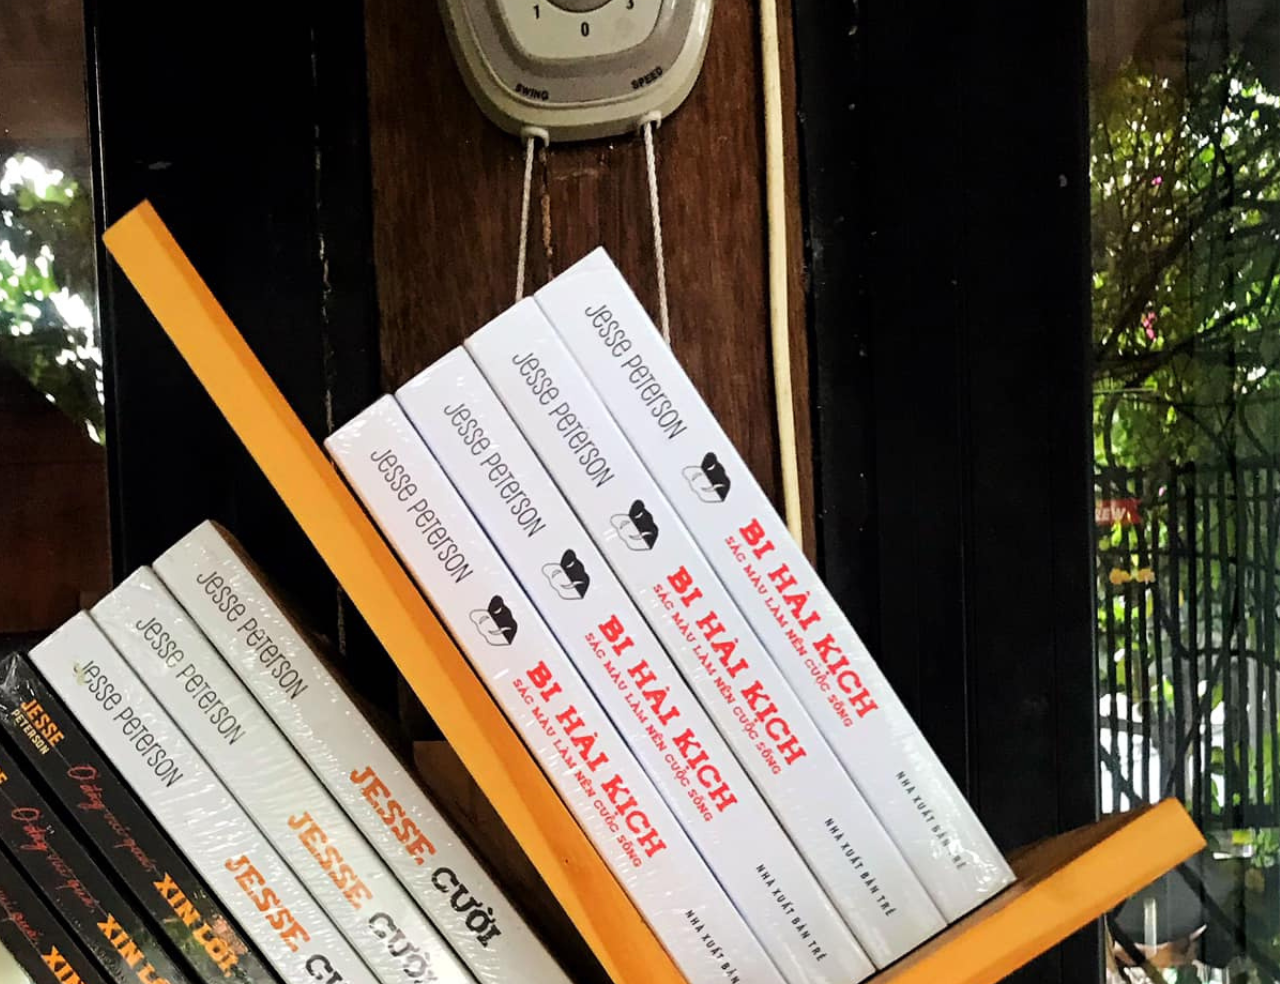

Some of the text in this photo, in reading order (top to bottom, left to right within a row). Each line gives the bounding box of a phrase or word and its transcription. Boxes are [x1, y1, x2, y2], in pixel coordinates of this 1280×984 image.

[532, 4, 541, 20] 1
[579, 20, 591, 38] 0
[514, 81, 551, 102] SWING
[629, 65, 665, 91] SPEED
[737, 516, 880, 720] BI HÀI KỊCH
[665, 564, 808, 767] BI HÀI KỊCH
[671, 610, 697, 643] MÀU
[692, 644, 718, 677] LÀM
[713, 675, 738, 705] NÊN
[733, 706, 760, 741] CUỘC
[10, 707, 51, 756] PETERSON
[20, 698, 65, 747] JESSE
[597, 613, 740, 814] BI HÀI KỊCH
[524, 658, 669, 859] BI HÀI KỊCH
[287, 811, 373, 910] JESSE
[348, 764, 503, 950] JESSE CƯỜI
[823, 816, 846, 843] NHÀ
[839, 840, 865, 871] XUẤT
[858, 870, 881, 896] BẢN
[153, 872, 202, 928] XIN
[224, 854, 312, 953] JESSE
[96, 914, 145, 969] XIN
